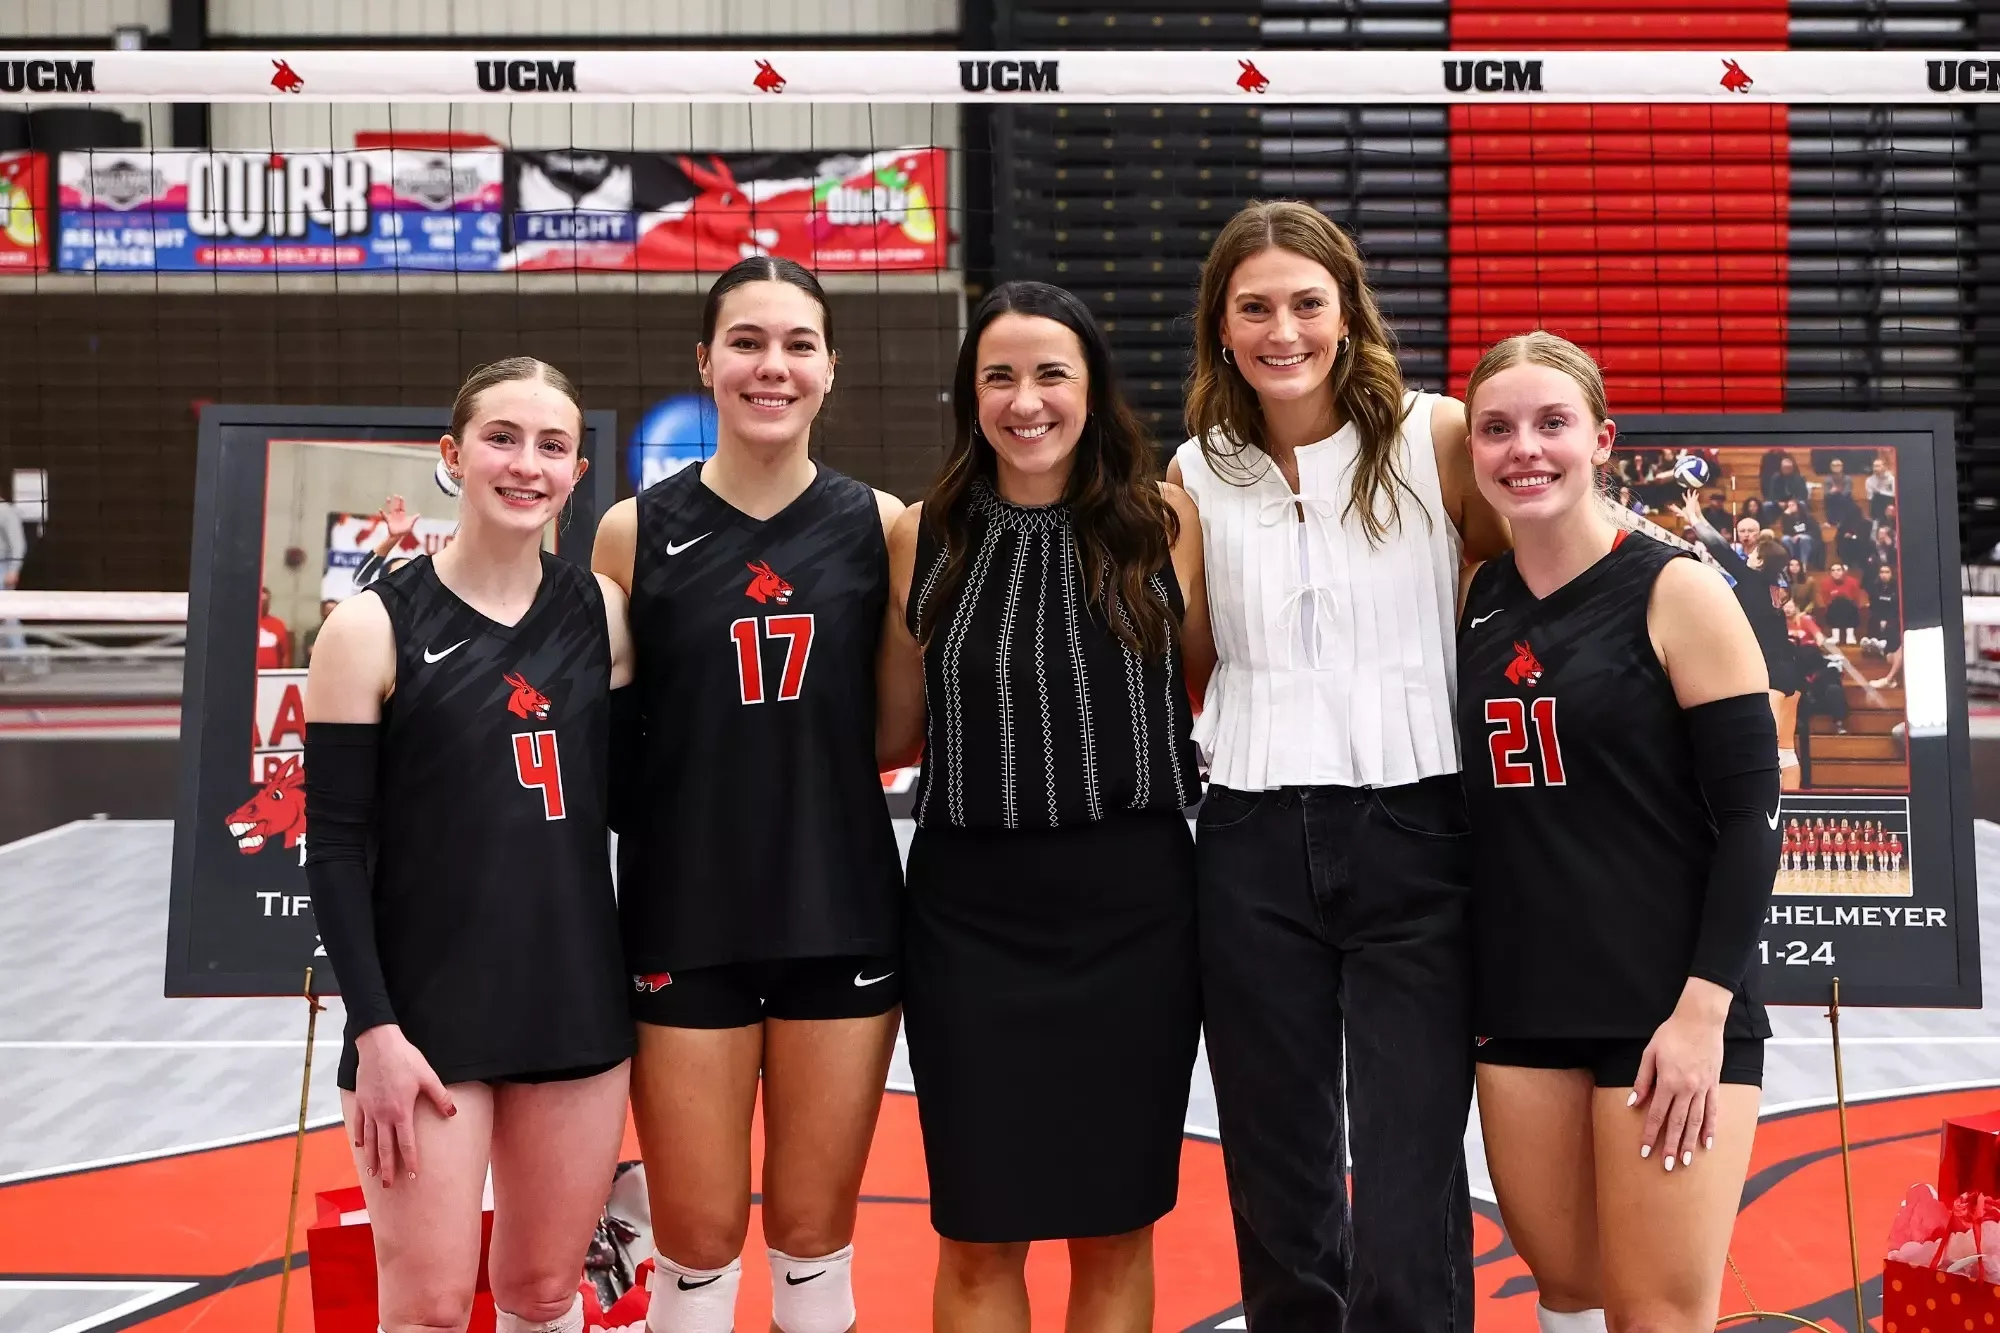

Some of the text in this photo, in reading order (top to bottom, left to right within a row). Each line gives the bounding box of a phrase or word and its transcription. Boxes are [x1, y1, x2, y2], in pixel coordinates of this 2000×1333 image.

[0, 59, 96, 93] UCM
[475, 59, 577, 93] UCM
[958, 60, 1060, 93] UCM
[1442, 60, 1544, 94] UCM
[528, 215, 626, 239] FLIGHT
[201, 247, 265, 264] HARD
[730, 614, 815, 705] 17
[1484, 696, 1567, 788] 21
[511, 731, 566, 821] 4
[1758, 940, 1836, 967] 1-24
